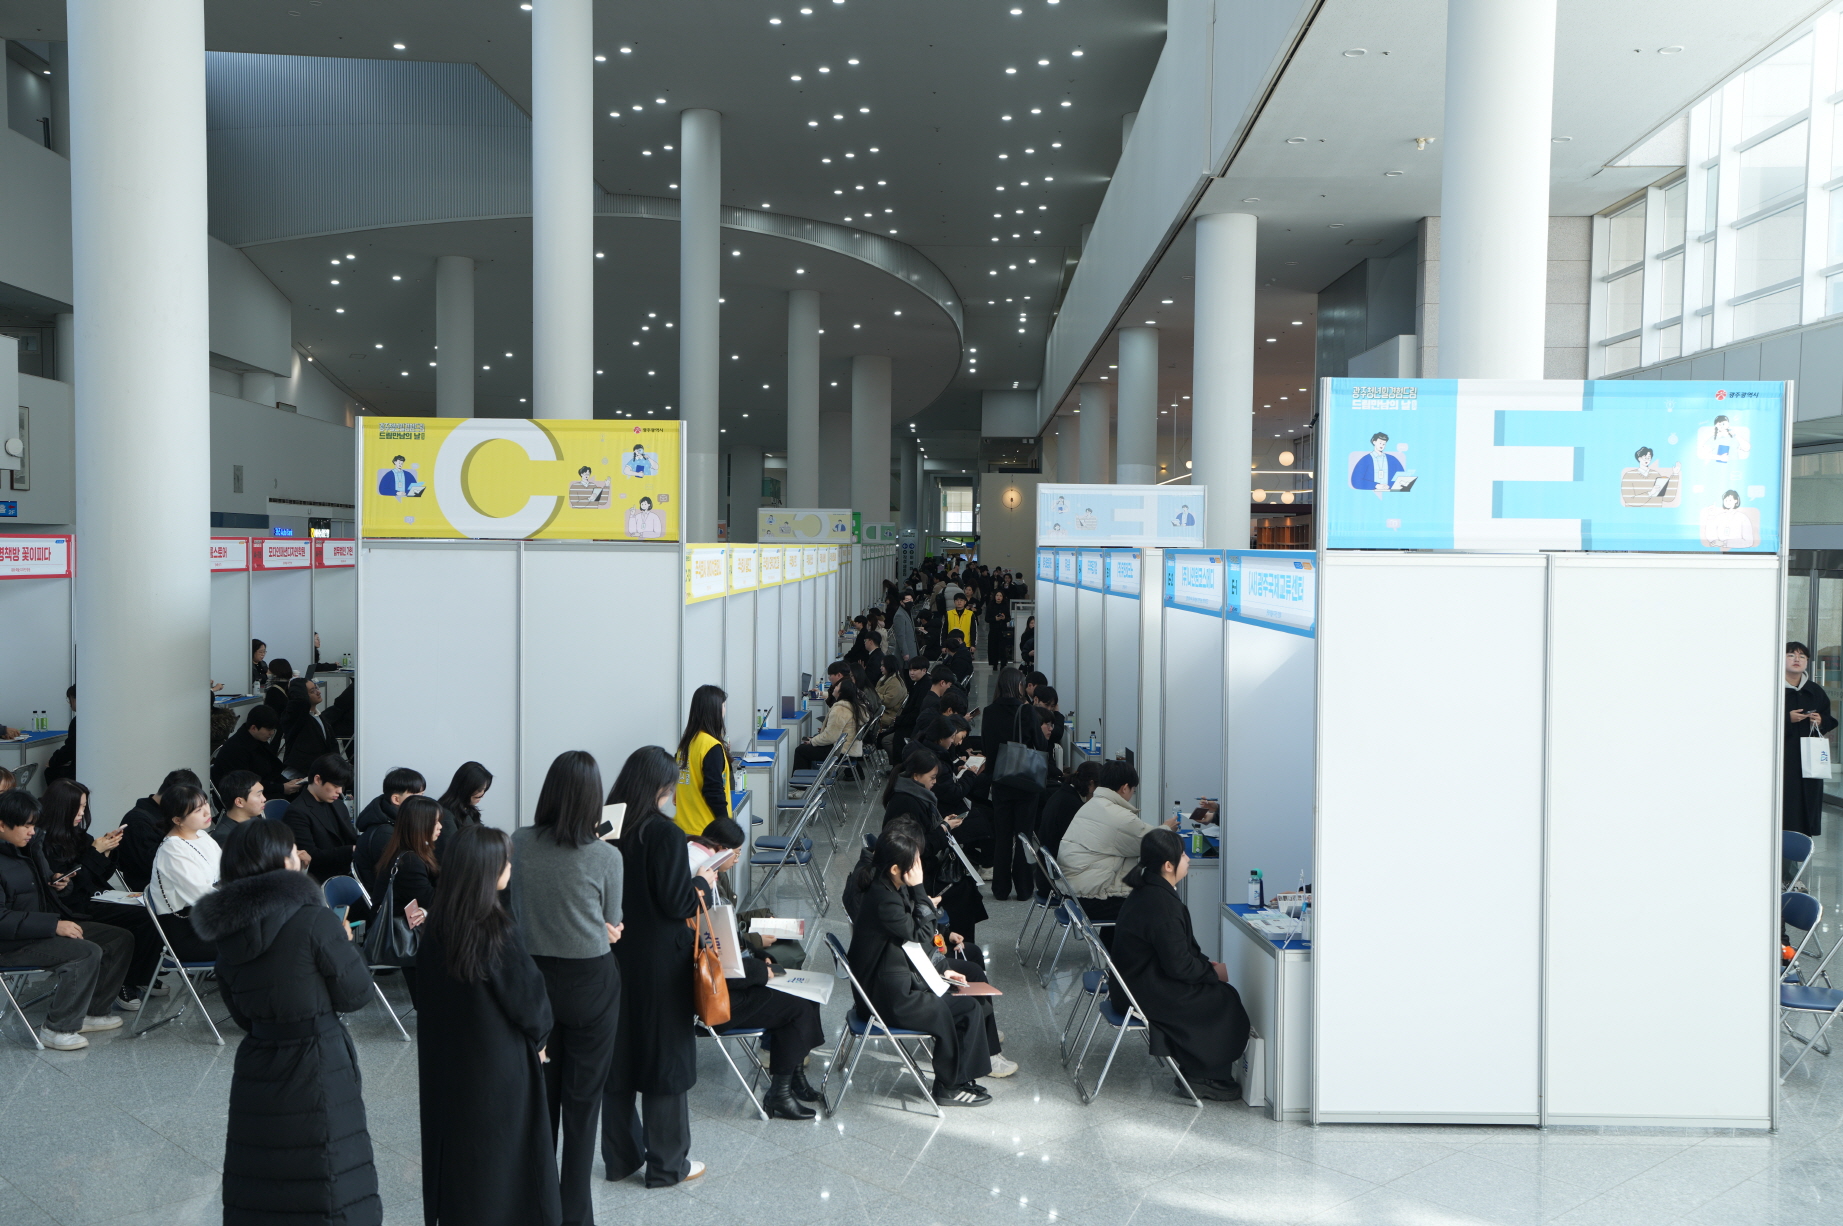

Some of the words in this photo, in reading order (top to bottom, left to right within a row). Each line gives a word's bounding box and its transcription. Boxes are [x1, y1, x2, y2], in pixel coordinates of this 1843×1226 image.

[1352, 400, 1398, 410] 드림만남의
[1401, 400, 1411, 410] 날
[433, 418, 565, 540] C
[1455, 379, 1593, 551] E
[22, 546, 52, 561] 꽃이피다
[1248, 571, 1305, 602] (사)광주국제교류센터
